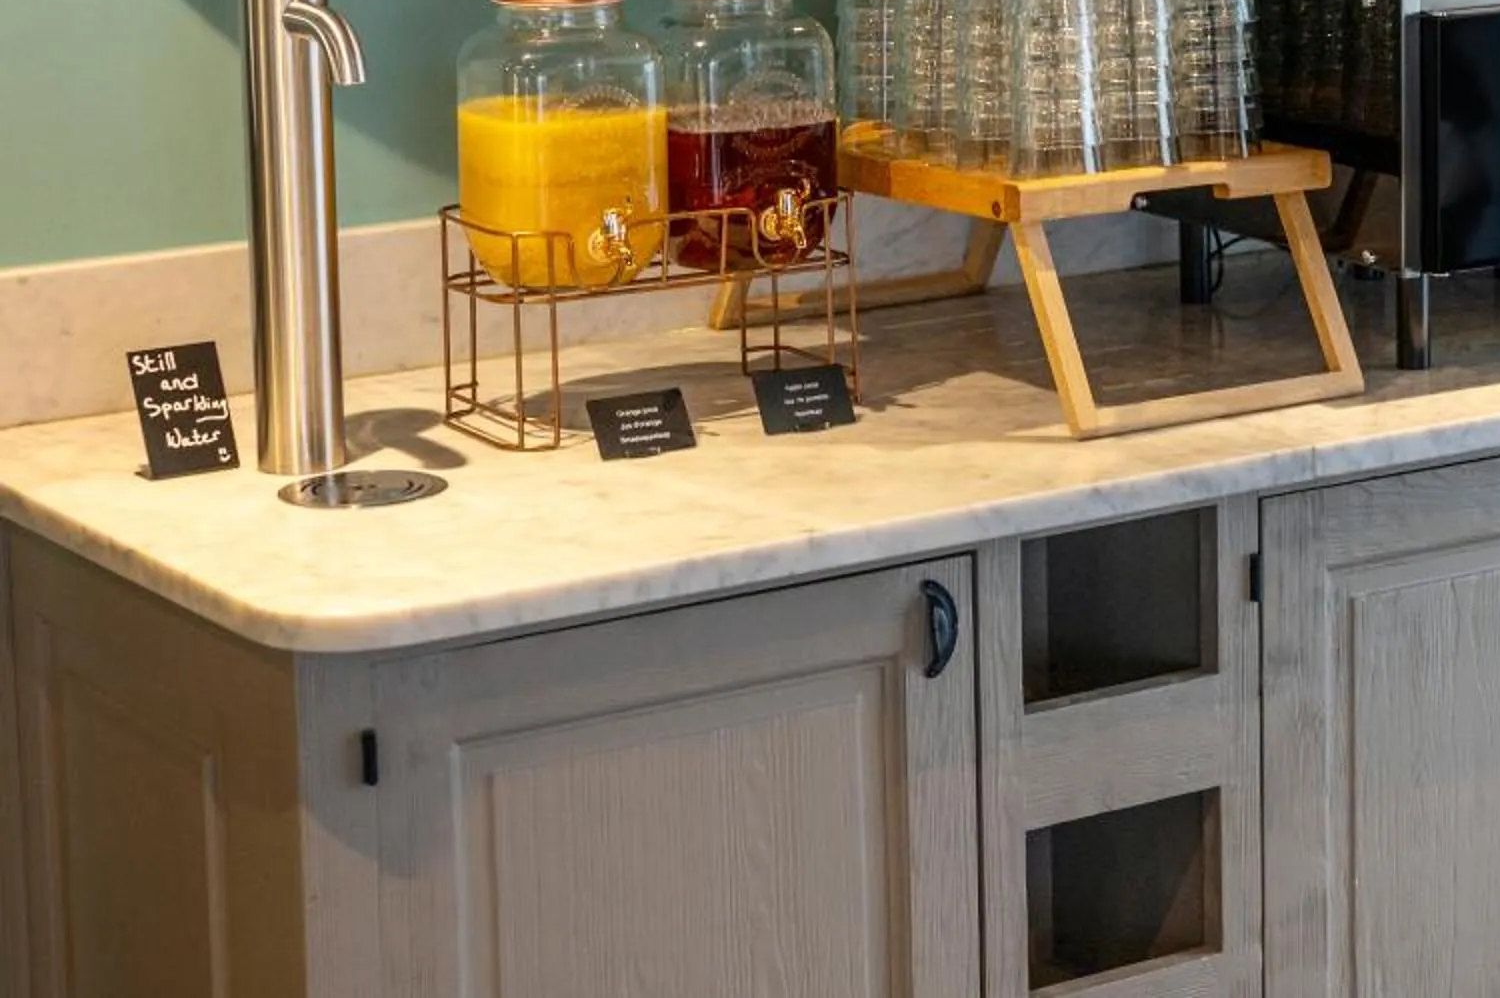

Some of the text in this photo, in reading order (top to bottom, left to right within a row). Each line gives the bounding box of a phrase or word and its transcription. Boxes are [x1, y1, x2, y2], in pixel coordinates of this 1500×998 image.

[131, 351, 176, 375] Still
[160, 373, 198, 390] and
[143, 394, 229, 423] Sparkling
[165, 427, 221, 448] Water
